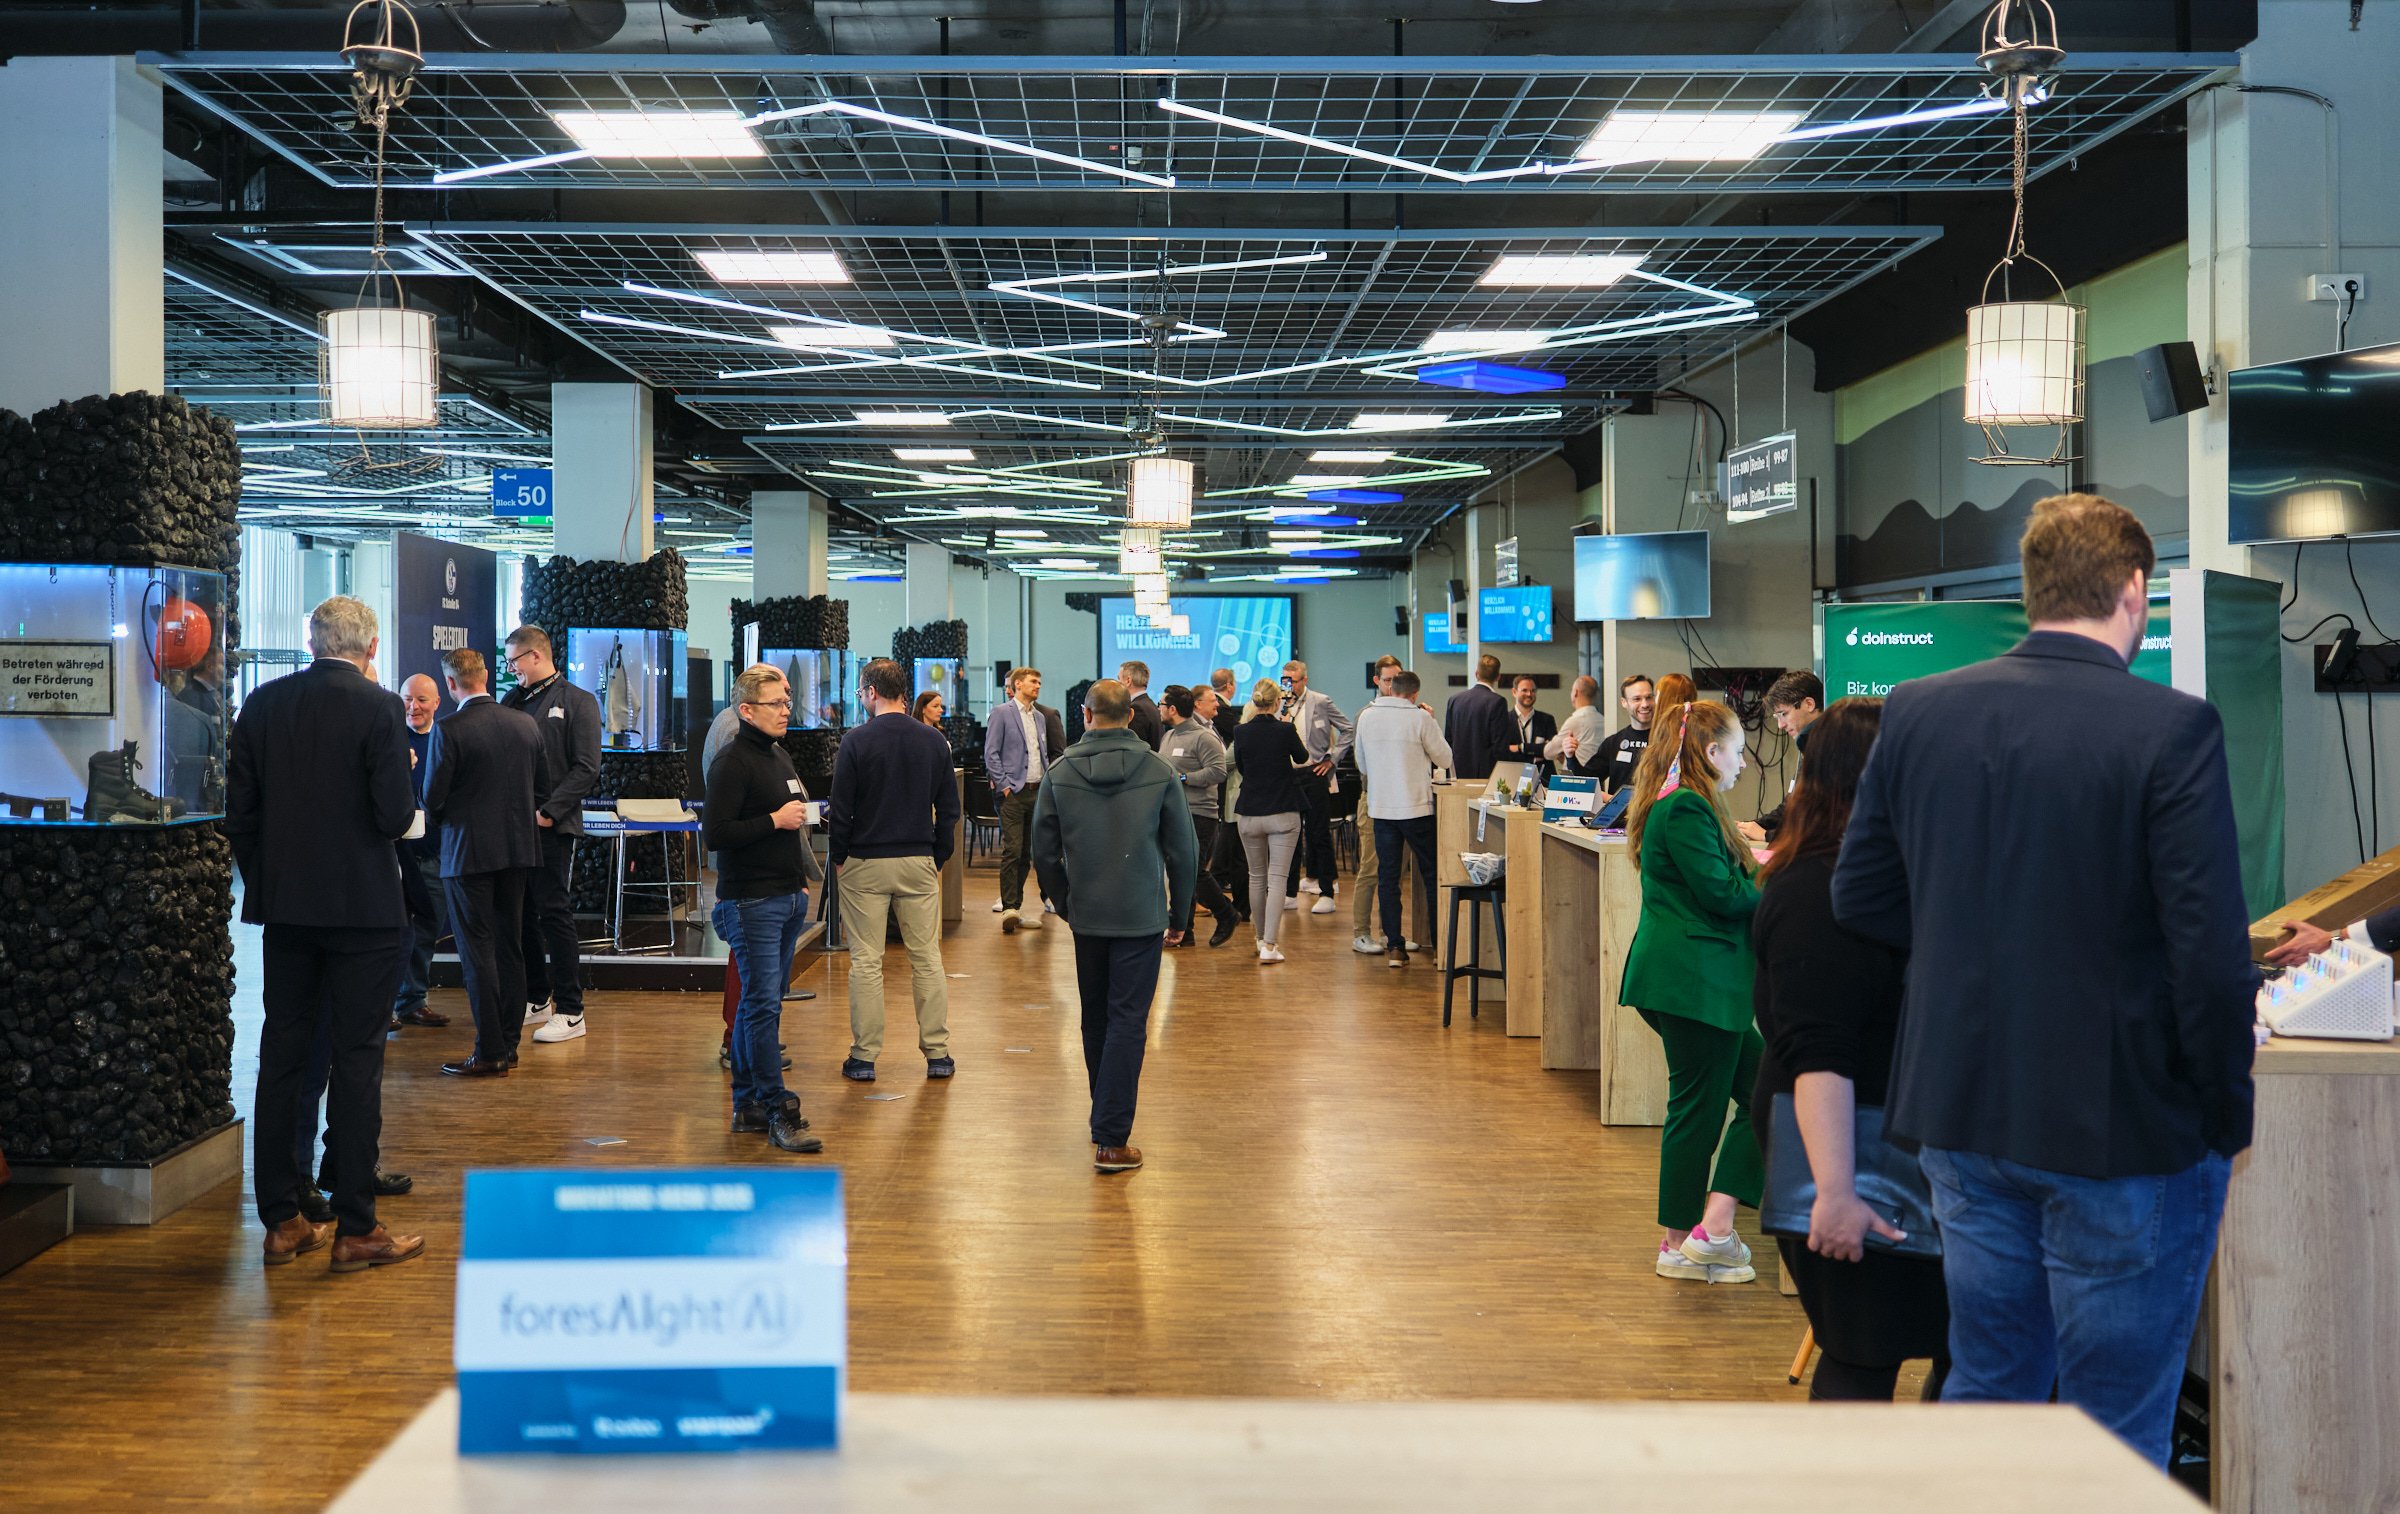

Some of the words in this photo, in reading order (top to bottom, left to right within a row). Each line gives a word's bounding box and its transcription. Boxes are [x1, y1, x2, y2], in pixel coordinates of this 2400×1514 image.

[495, 499, 516, 507] Block
[517, 485, 546, 506] 50
[433, 624, 469, 650] SPIELERTALK
[1116, 634, 1200, 650] WILLKOMMEN
[1861, 632, 1934, 646] doinstruct
[2, 659, 53, 669] Betreten
[56, 659, 104, 670] während
[12, 675, 31, 685] der
[34, 674, 94, 687] Förderung
[27, 690, 78, 700] verboten
[1847, 682, 1869, 695] Biz
